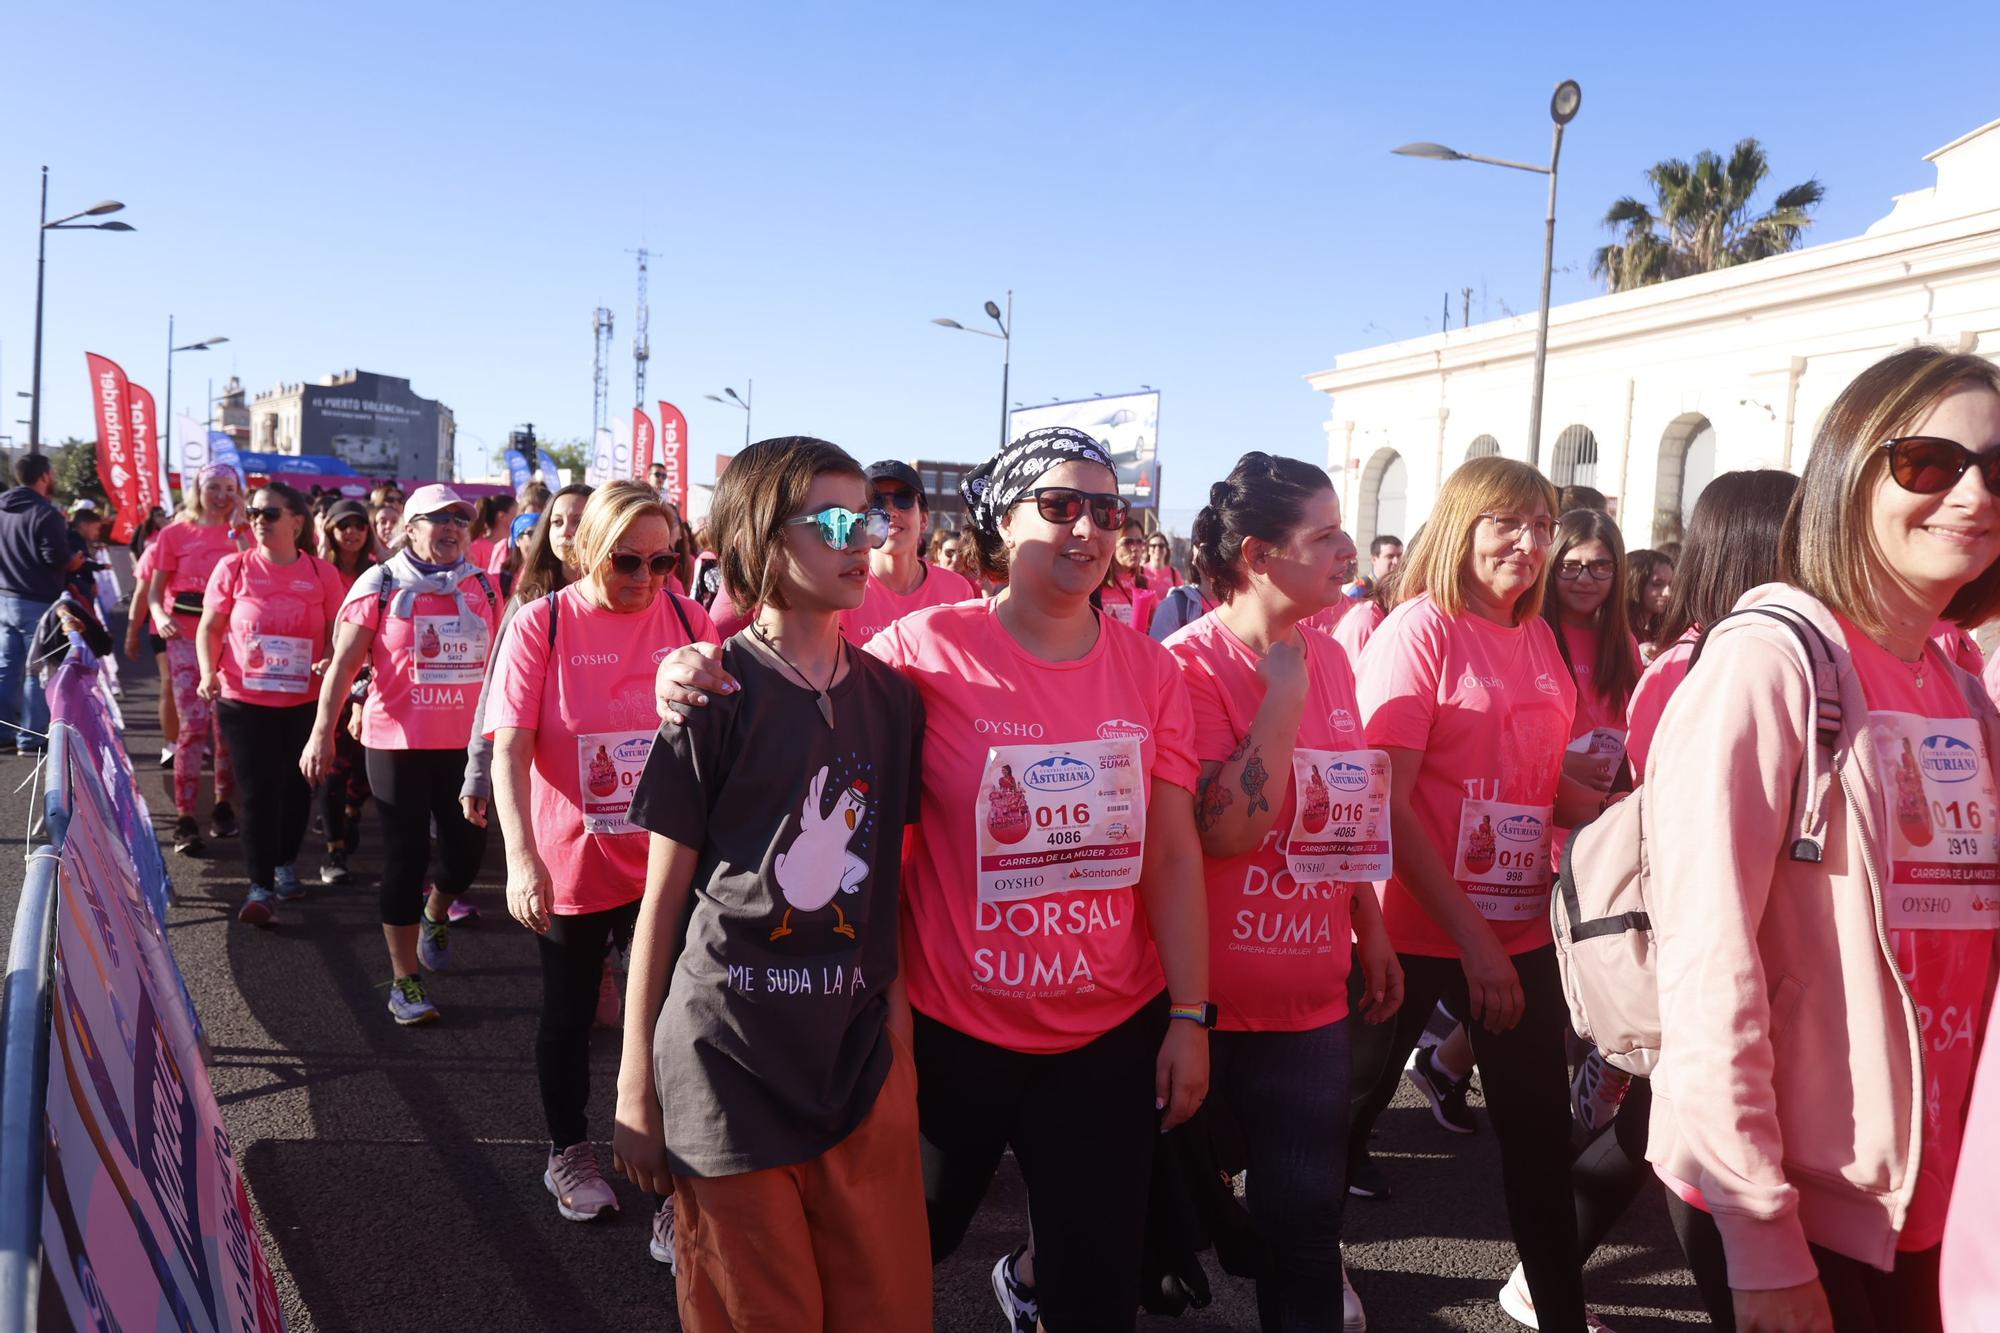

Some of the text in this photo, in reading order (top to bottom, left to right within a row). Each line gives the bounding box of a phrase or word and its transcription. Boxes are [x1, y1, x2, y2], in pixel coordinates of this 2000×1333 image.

[443, 642, 468, 653] 016
[571, 653, 619, 666] OYSHO
[411, 687, 465, 705] SUMA
[974, 718, 1044, 739] OYSHO
[1099, 759, 1131, 770] SUMA
[1030, 769, 1090, 785] ASTURIANA
[1036, 803, 1090, 827] 016
[1331, 803, 1363, 821] 016
[1932, 801, 1982, 829] 016
[1047, 831, 1081, 845] 4086
[1334, 826, 1356, 837] 4085
[999, 848, 1129, 867] CARRERA DE LA MUJER 2023
[1498, 850, 1534, 868] 016
[1081, 867, 1131, 879] Santander
[1295, 862, 1325, 873] OYSHO
[1910, 868, 1951, 879] CARRERA
[995, 875, 1044, 891] OYSHO
[1506, 871, 1523, 881] 998
[1902, 897, 1951, 913] OYSHO
[976, 895, 1120, 937] DORSAL
[1232, 910, 1331, 944] SUMA
[972, 948, 1093, 986] SUMA
[727, 963, 754, 992] ME
[766, 967, 812, 995] SUDA
[823, 965, 844, 995] LA
